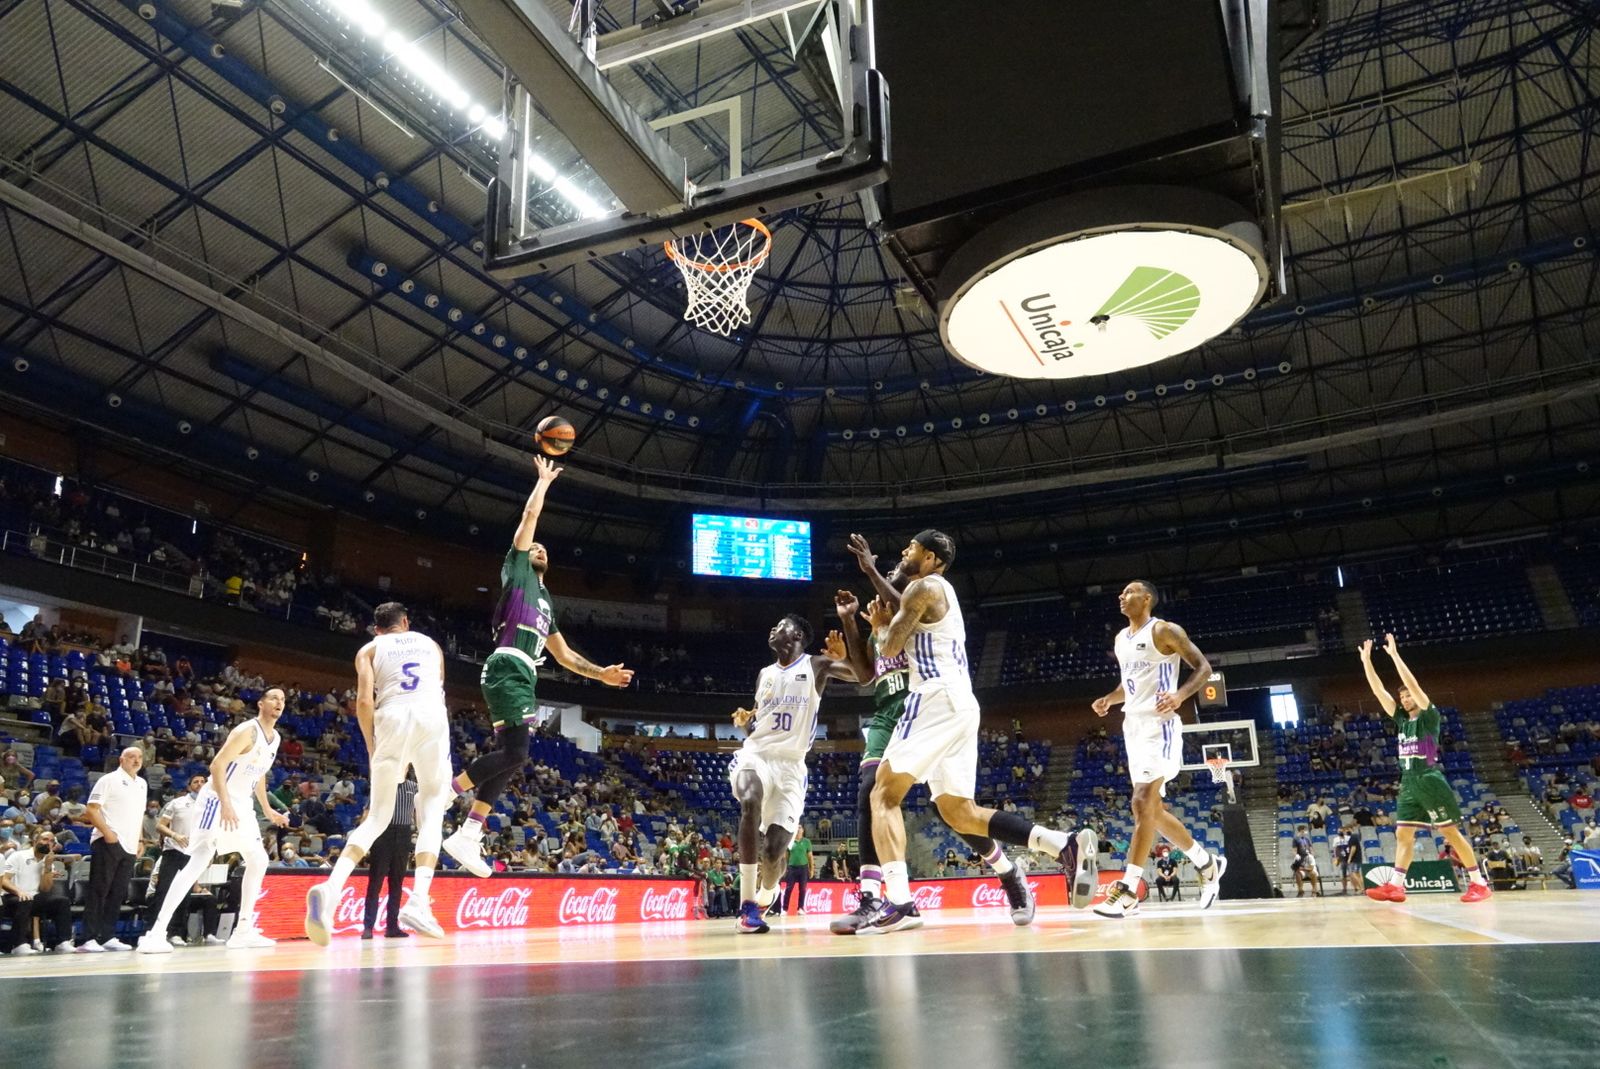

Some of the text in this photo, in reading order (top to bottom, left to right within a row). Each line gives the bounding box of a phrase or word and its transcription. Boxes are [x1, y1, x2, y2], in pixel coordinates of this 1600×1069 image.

[1020, 293, 1084, 361] Unicaja
[401, 662, 420, 690] 5
[1126, 678, 1136, 695] 8
[1206, 686, 1217, 700] 9
[771, 712, 793, 731] 30
[1404, 876, 1453, 889] Unicaja
[456, 887, 533, 928] Coca-Cola
[559, 887, 620, 924] Coca-Cola
[640, 887, 690, 920] Coca-Cola
[803, 888, 833, 913] Coca-Cola
